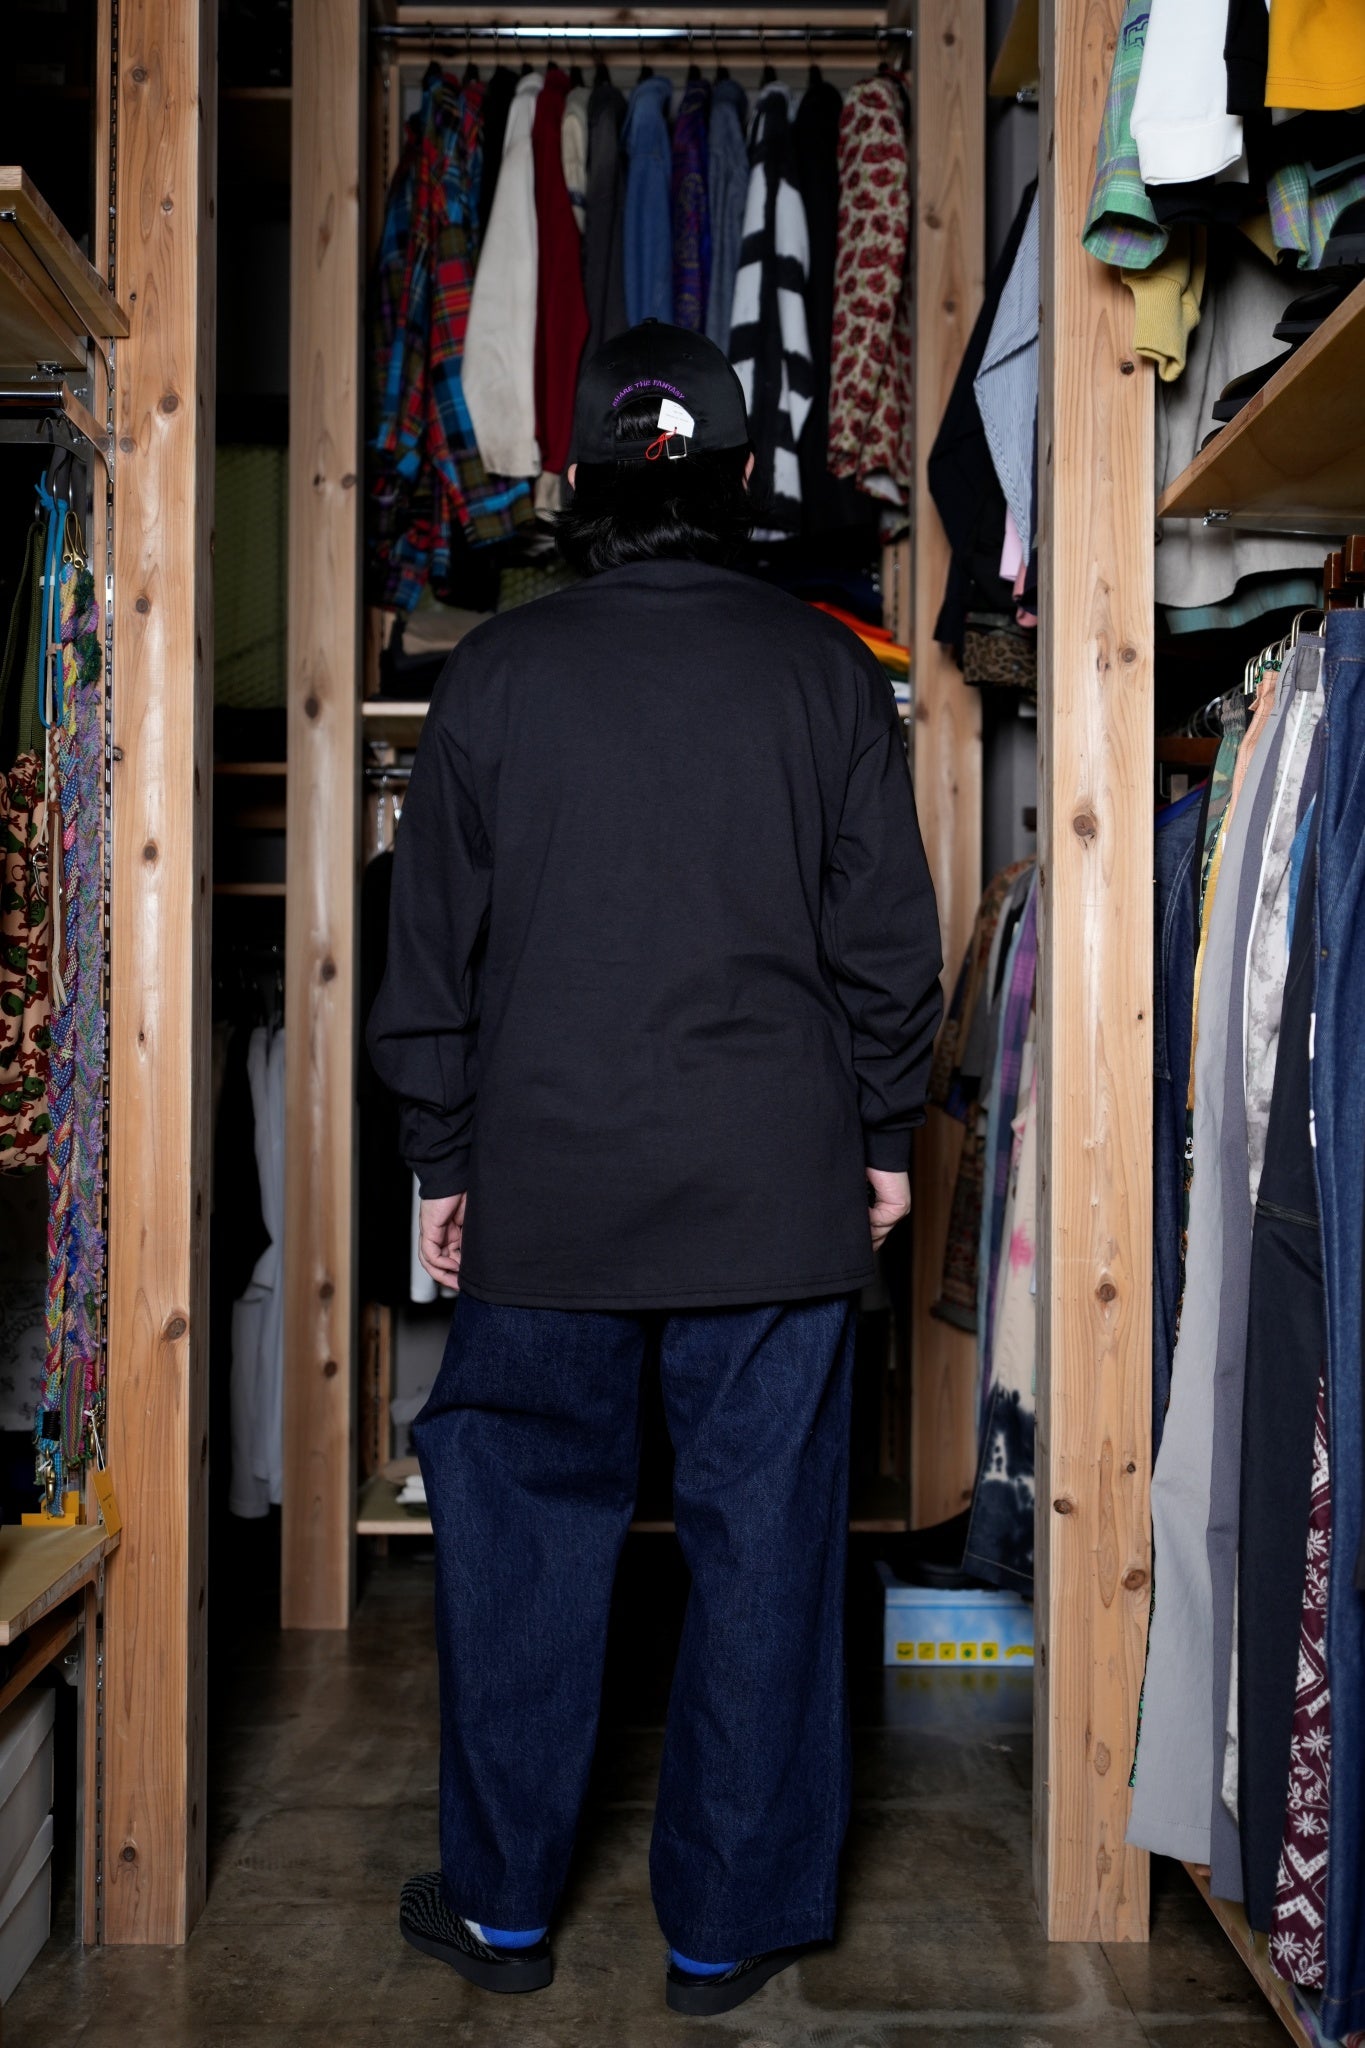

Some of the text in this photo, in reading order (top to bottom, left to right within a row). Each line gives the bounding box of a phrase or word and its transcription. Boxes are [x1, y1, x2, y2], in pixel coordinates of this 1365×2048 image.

[612, 379, 685, 407] SHARE THE FANTASY
